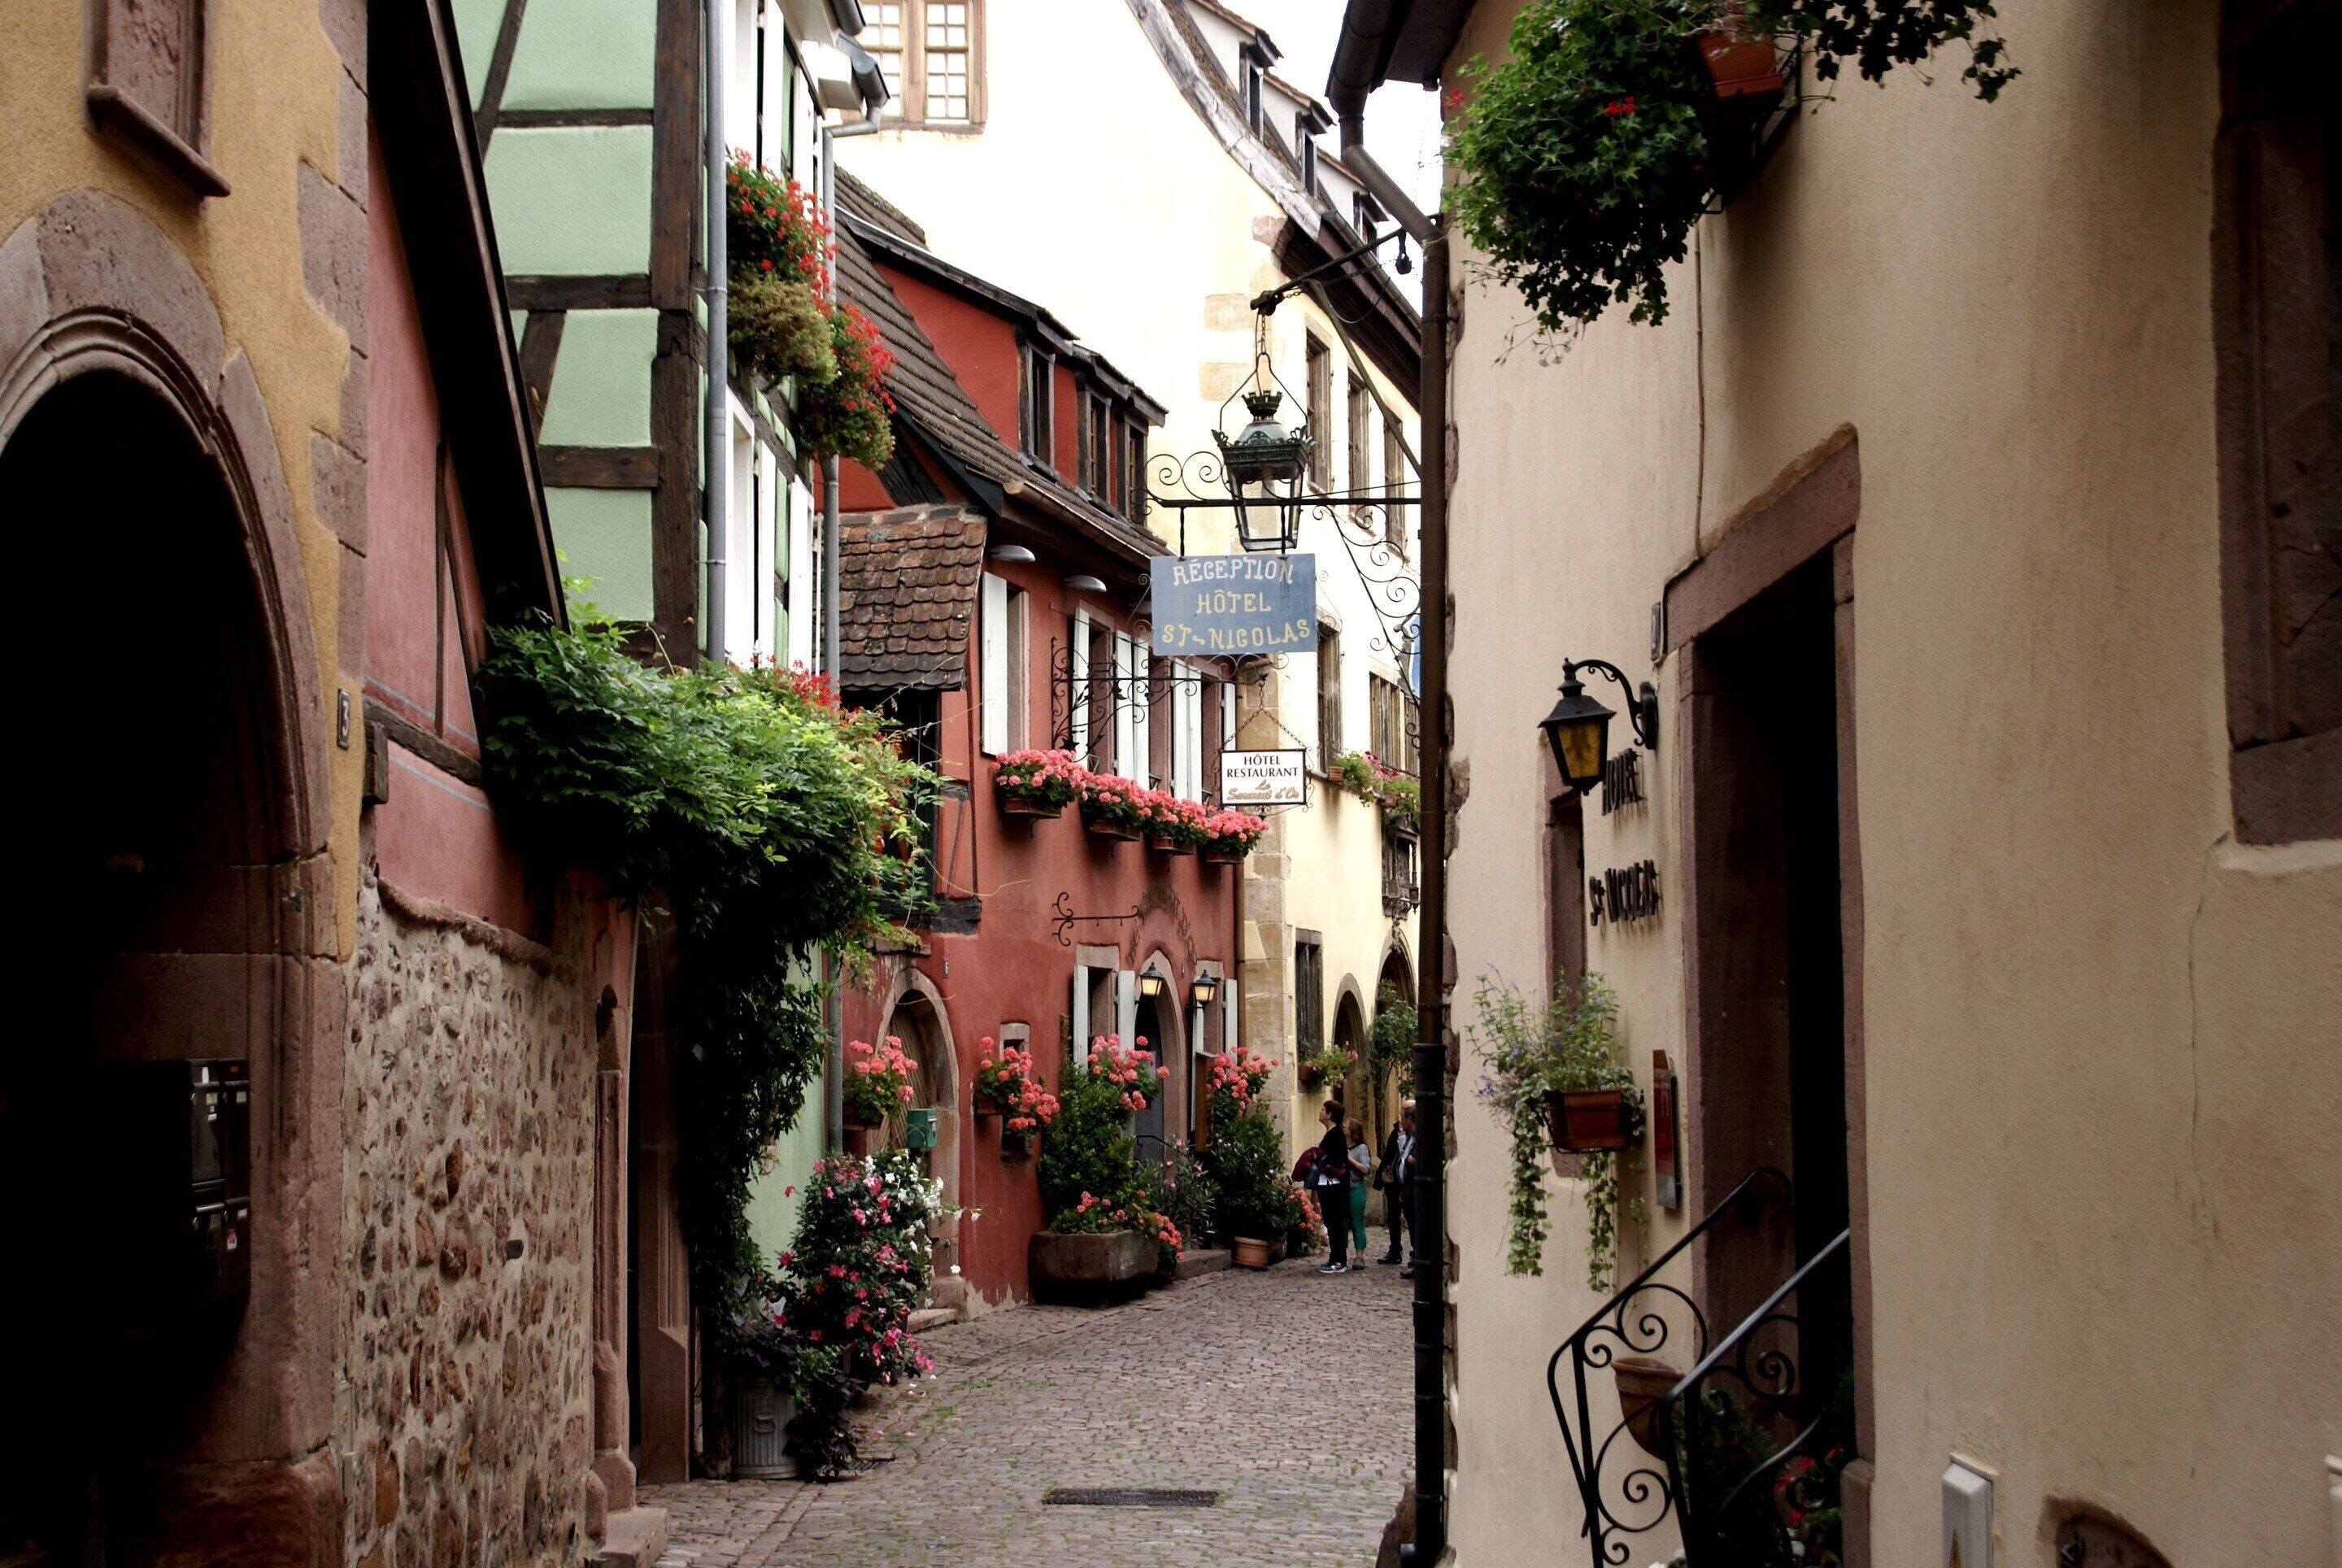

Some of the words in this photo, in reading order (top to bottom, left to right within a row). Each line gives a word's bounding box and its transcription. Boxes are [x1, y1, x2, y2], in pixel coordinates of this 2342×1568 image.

[1173, 556, 1294, 586] RÉCEPTION
[1195, 589, 1272, 615] HÔTEL
[342, 699, 350, 737] 3
[1226, 767, 1299, 777] RESTAURANT
[1243, 754, 1281, 765] HÔTEL
